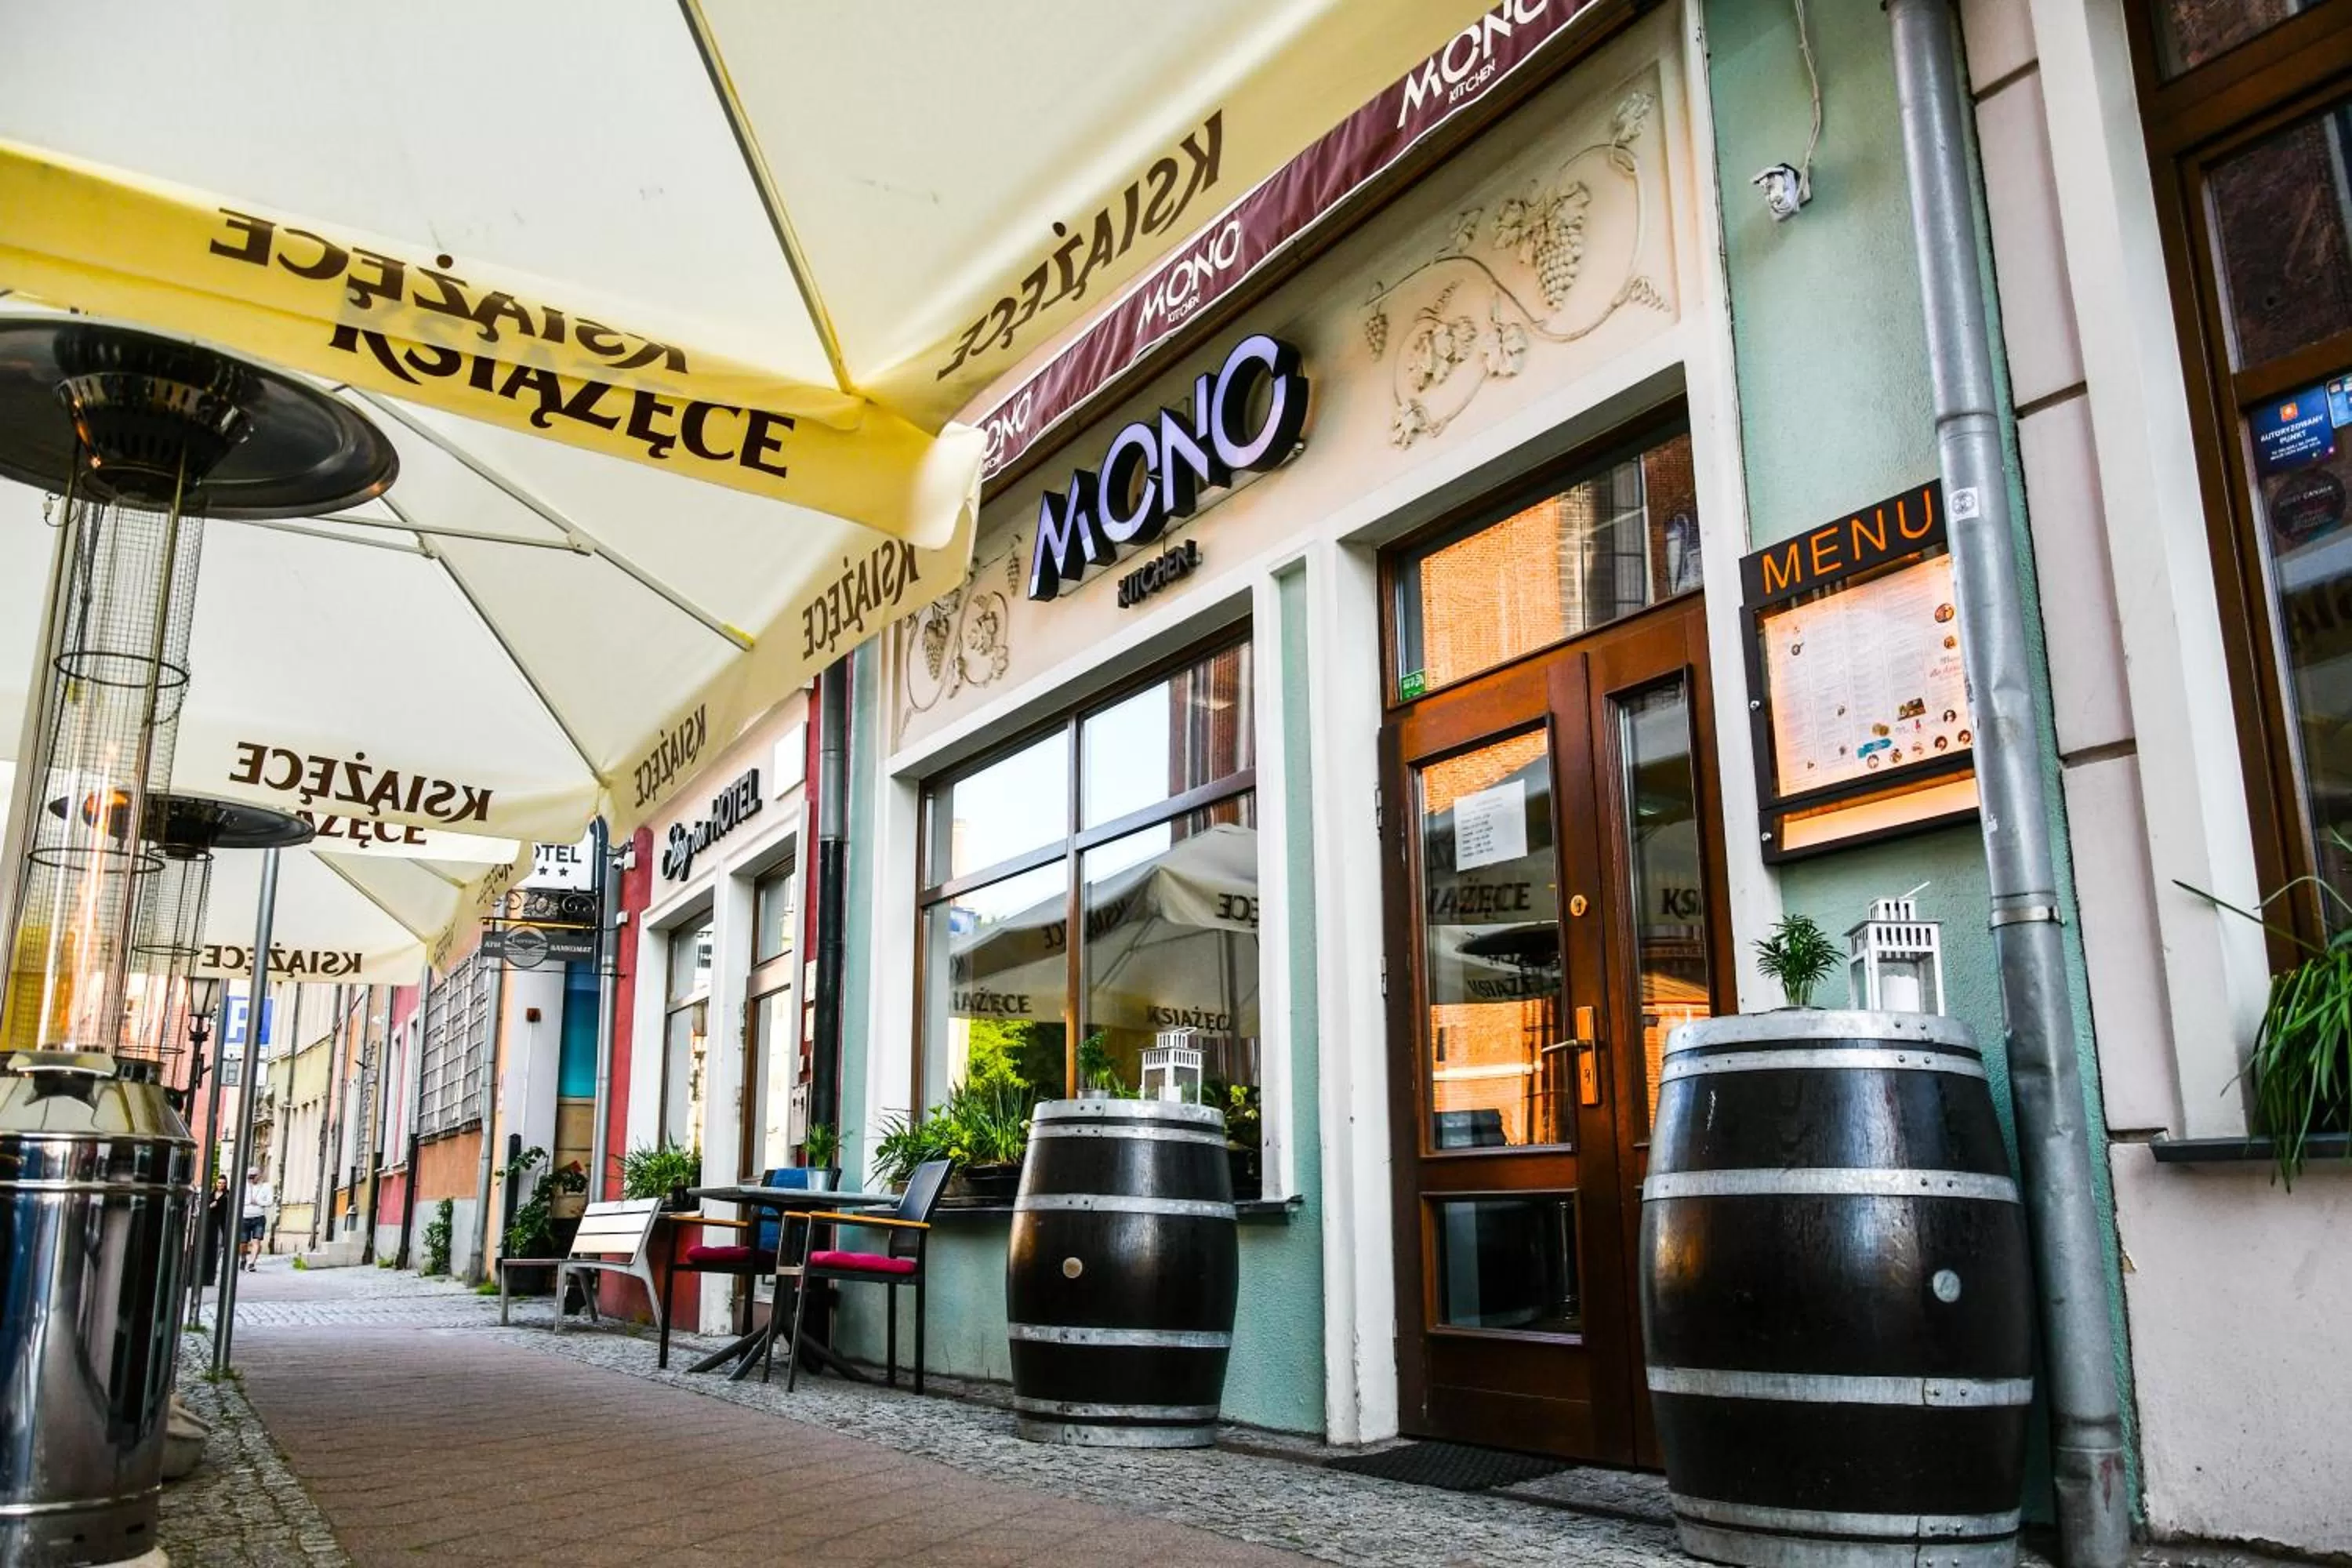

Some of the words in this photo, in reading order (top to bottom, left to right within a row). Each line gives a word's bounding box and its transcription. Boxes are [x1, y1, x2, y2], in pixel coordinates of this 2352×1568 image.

[1448, 58, 1496, 104] KITCHEN
[1137, 220, 1241, 336] MONO
[984, 391, 1033, 460] ONO
[1029, 334, 1308, 601] MONO
[1117, 539, 1203, 608] KITCHEN
[1761, 489, 1934, 595] MENU
[535, 844, 582, 863] TEL
